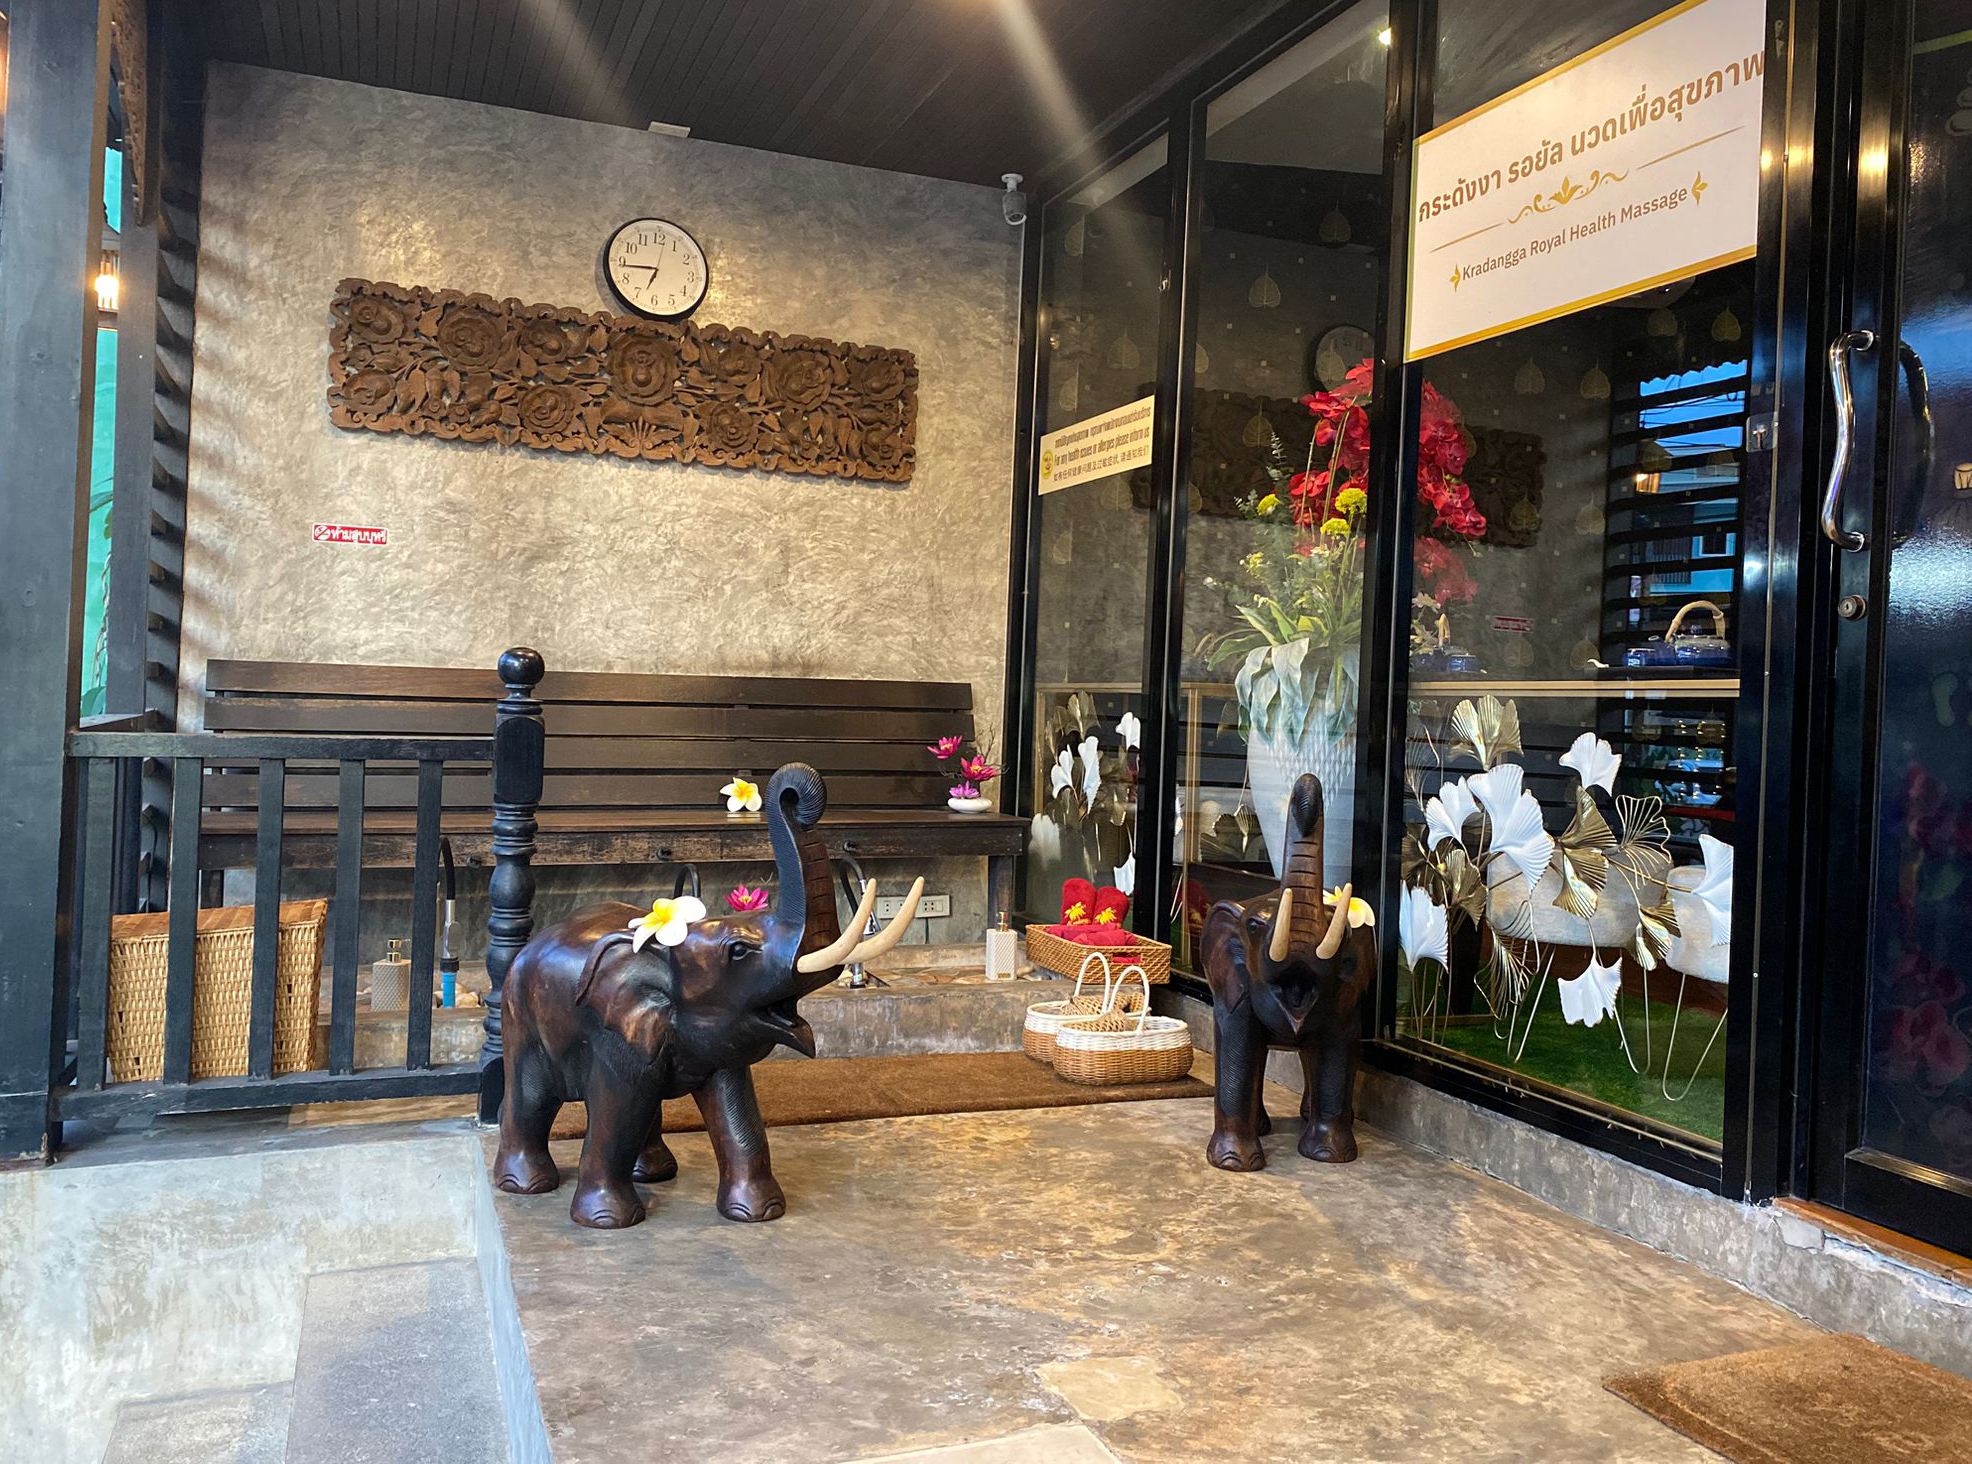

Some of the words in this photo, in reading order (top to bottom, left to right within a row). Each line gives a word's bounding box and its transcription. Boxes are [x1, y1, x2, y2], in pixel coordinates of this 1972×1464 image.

[1418, 169, 1501, 223] กระดังงา
[1507, 139, 1563, 184] รอยัล
[1570, 50, 1765, 156] นวดเพื่อสุขภาพ
[638, 233, 648, 247] 11
[653, 232, 666, 246] 12
[1462, 248, 1527, 281] Kradangga
[1530, 229, 1566, 256] Royal
[1570, 212, 1616, 241] Health
[1620, 188, 1688, 223] Massage
[625, 241, 638, 255] 10
[618, 255, 626, 268] 9
[682, 253, 690, 266] 2
[621, 272, 630, 285] 8
[687, 270, 695, 283] 3
[634, 286, 642, 299] 7
[680, 284, 687, 297] 4
[650, 294, 659, 307] 6
[667, 293, 676, 306] 5
